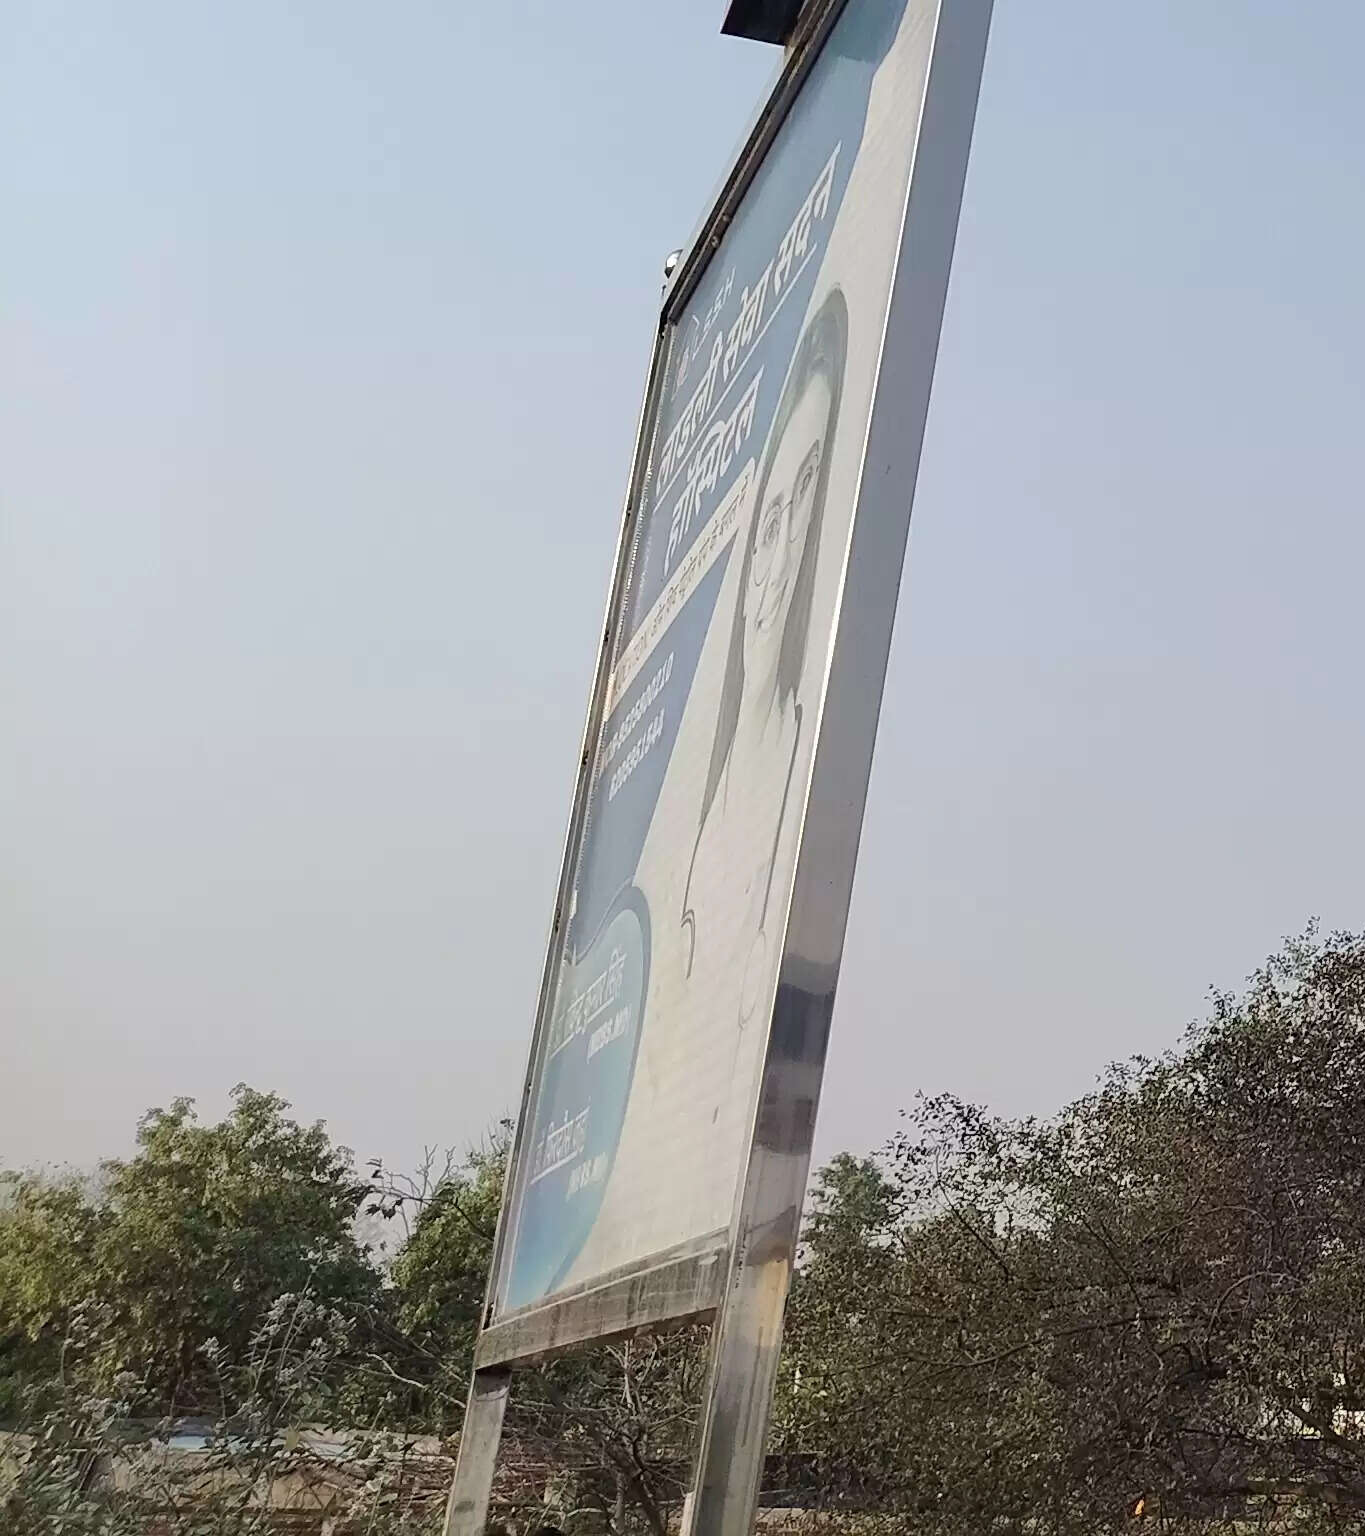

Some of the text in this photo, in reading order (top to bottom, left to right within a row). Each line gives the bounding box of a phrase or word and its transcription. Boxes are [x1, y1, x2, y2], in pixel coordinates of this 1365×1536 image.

[656, 138, 842, 497] लाडली सेवा सदन
[664, 364, 765, 577] हॉस्पिटल
